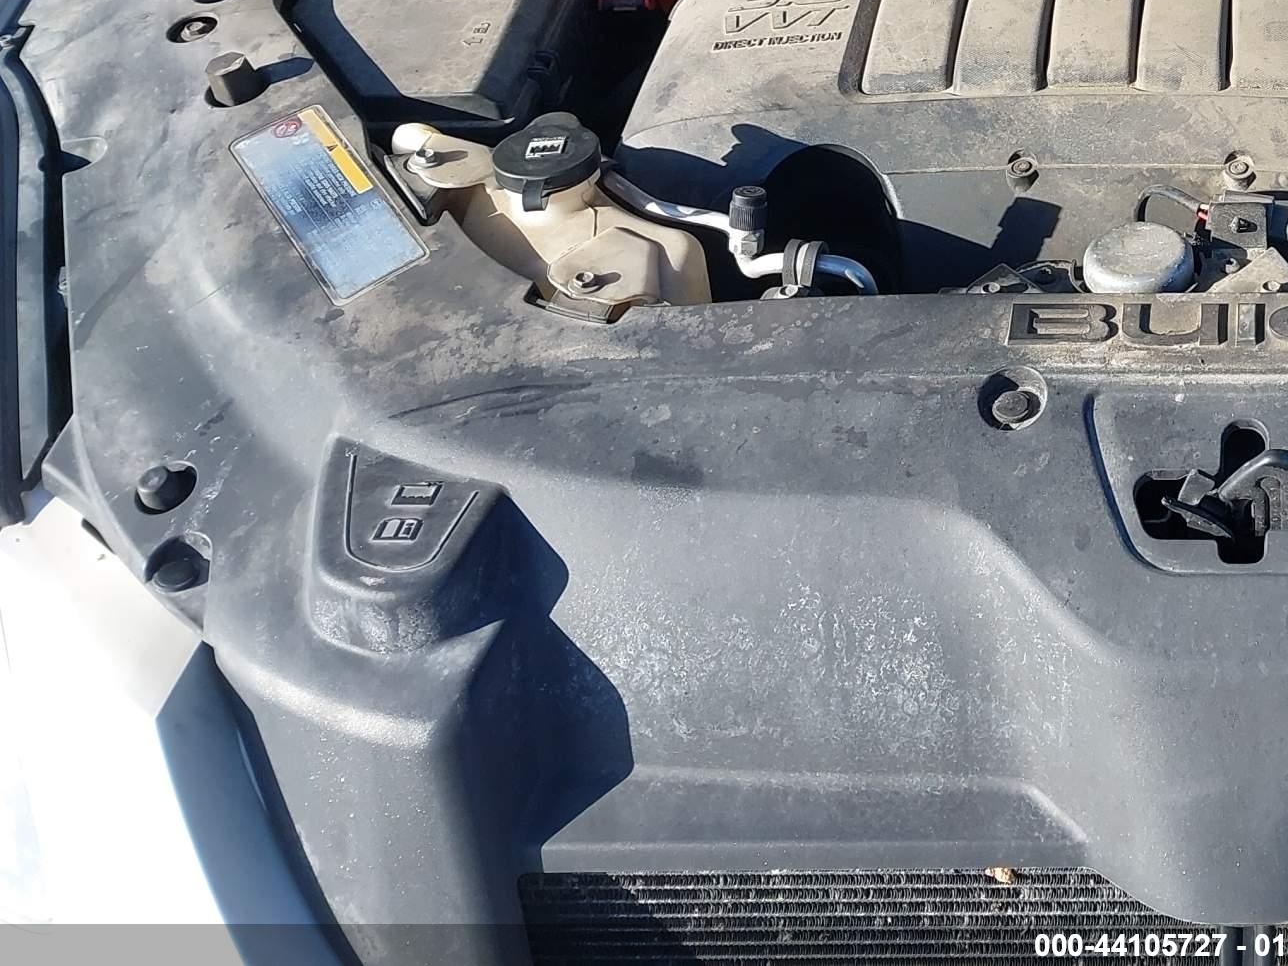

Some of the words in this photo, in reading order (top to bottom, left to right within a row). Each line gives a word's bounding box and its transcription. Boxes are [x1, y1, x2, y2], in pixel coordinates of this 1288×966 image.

[725, 5, 851, 35] VVT
[711, 38, 767, 52] DIRECT
[768, 31, 844, 48] INJECTION
